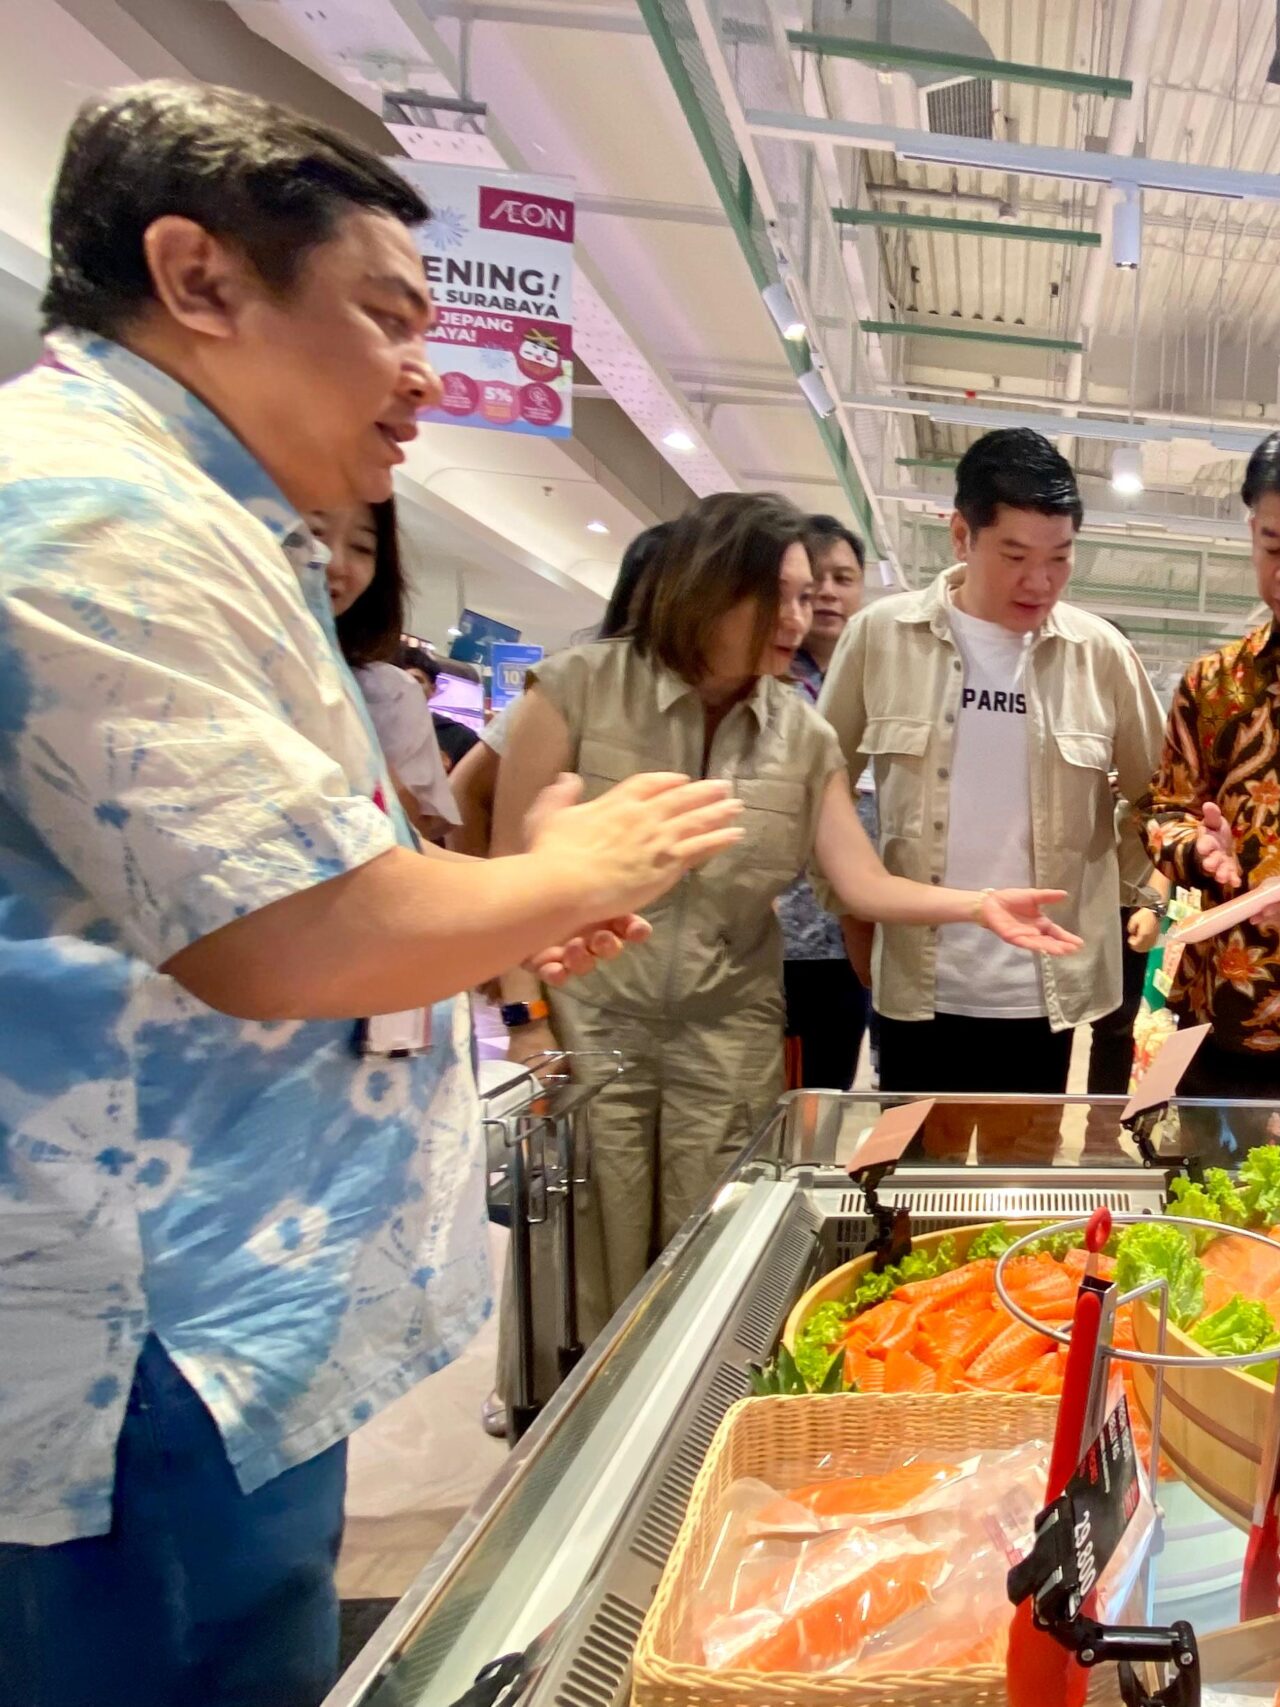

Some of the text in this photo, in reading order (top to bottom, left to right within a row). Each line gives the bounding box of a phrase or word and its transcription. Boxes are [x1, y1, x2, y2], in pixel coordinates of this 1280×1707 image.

[446, 289, 560, 319] SURABAYA
[440, 311, 514, 333] JEPANG
[962, 688, 1026, 713] PARIS
[1074, 1510, 1097, 1597] 29.800
